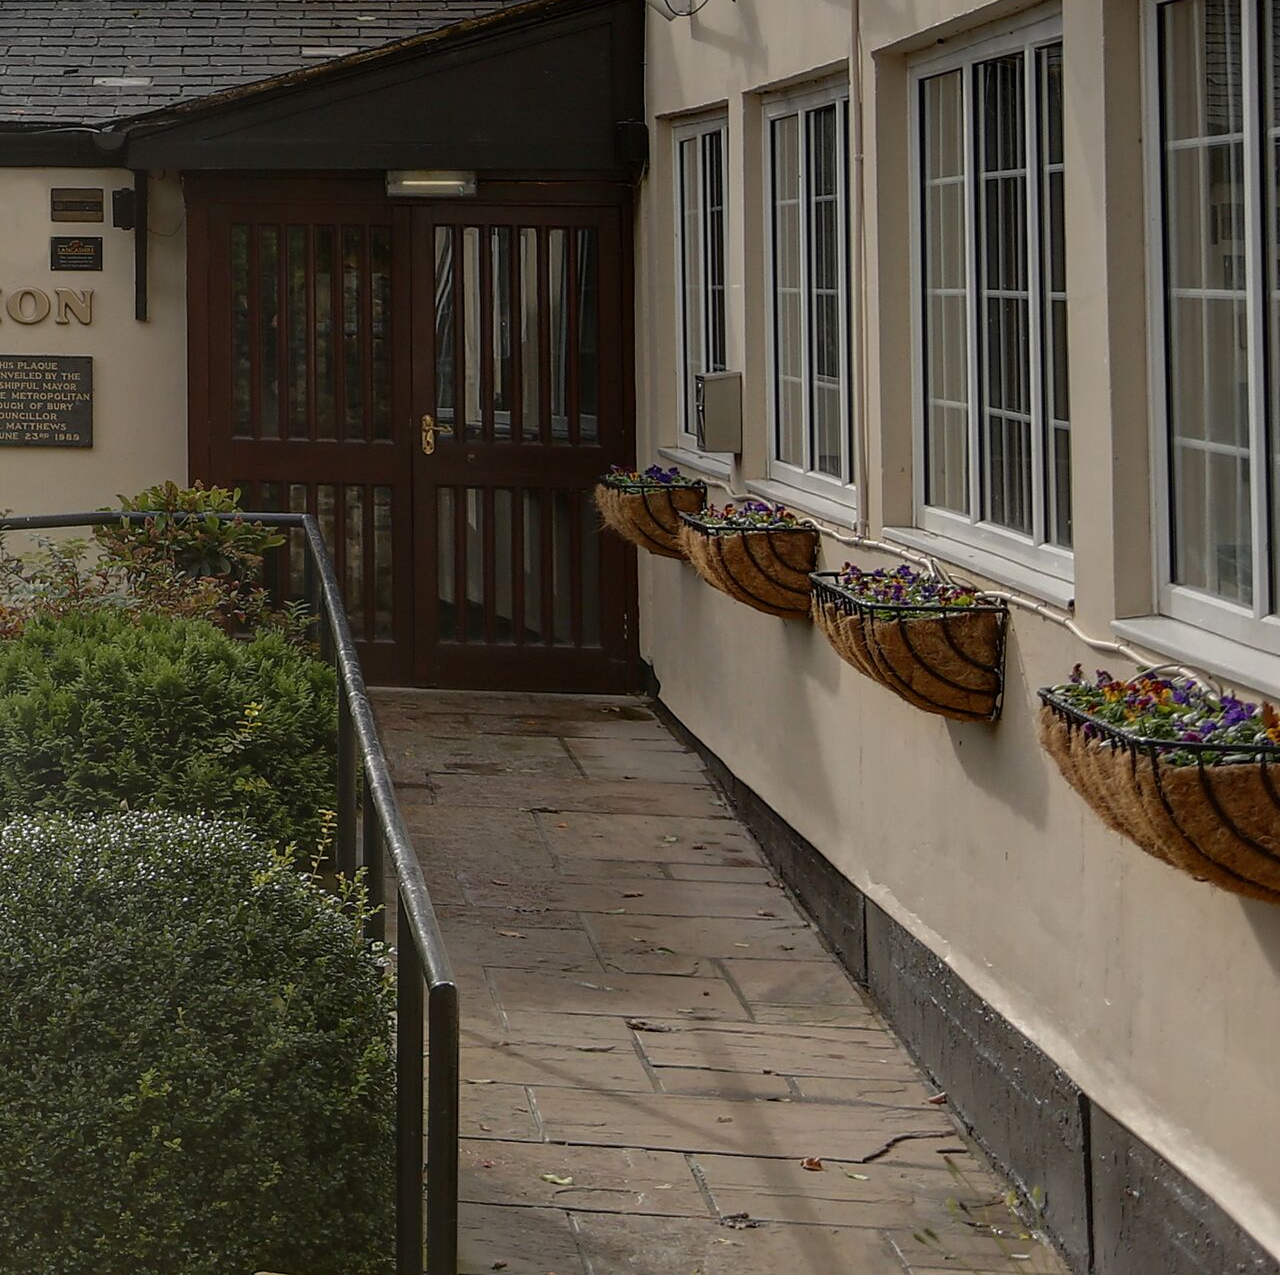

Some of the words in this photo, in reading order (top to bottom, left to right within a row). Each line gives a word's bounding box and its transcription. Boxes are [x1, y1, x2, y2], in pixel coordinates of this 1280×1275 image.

[17, 361, 58, 370] PLAQUE
[45, 372, 57, 380] BY
[61, 372, 81, 380] THE
[43, 382, 77, 391] MAYOR
[11, 391, 90, 401] METROPOLITAN
[29, 402, 43, 410] OF
[47, 402, 74, 411] BURY
[6, 422, 66, 431] MATTHEWS
